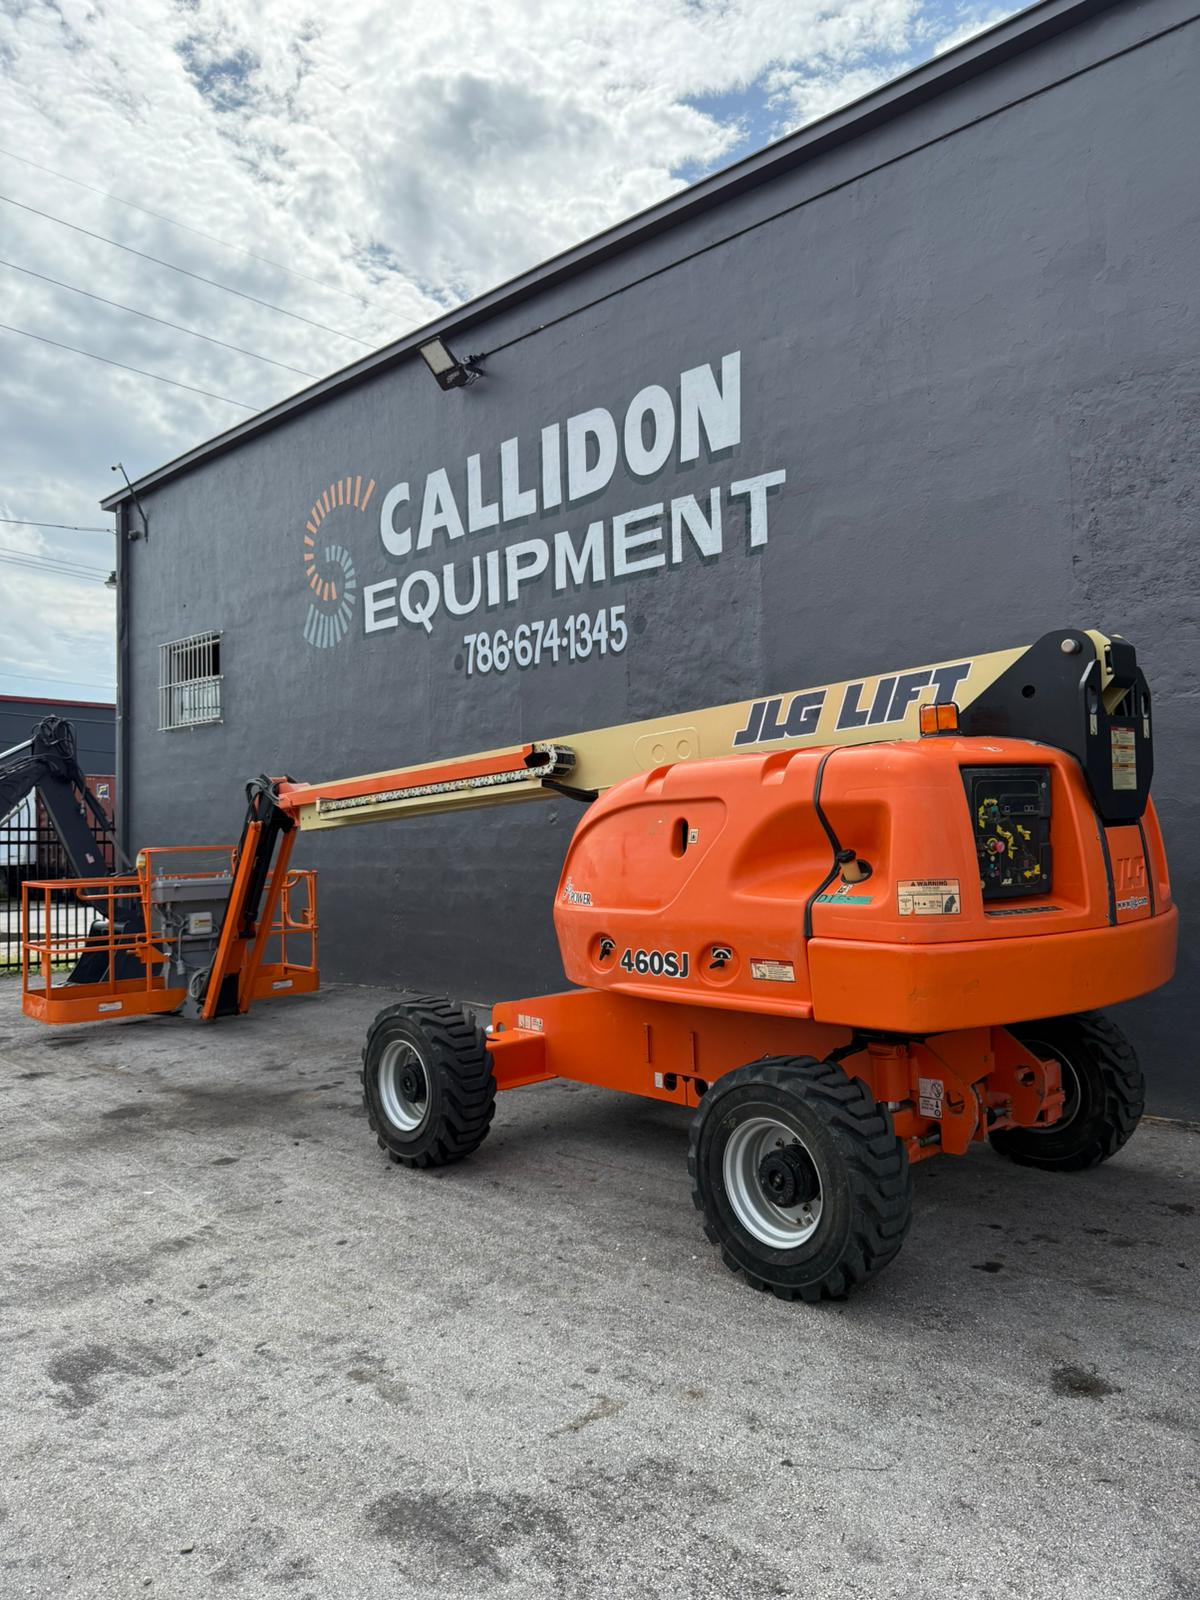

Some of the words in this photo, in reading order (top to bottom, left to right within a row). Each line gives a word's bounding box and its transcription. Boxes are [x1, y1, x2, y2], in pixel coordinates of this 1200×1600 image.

[380, 350, 741, 556] CALLIDON
[363, 469, 786, 633] EQUIPMENT
[732, 688, 828, 747] JLG
[834, 661, 973, 732] LIFT
[620, 948, 689, 979] 460SJ
